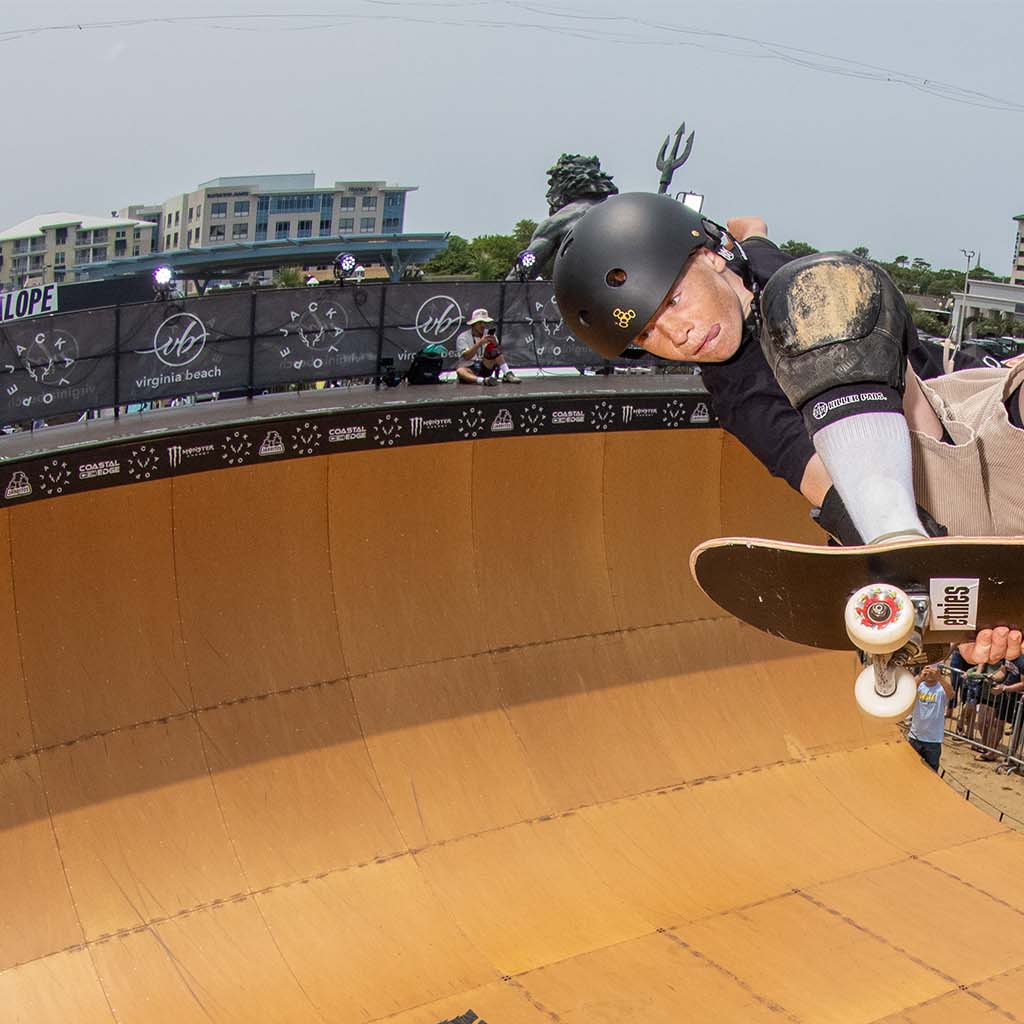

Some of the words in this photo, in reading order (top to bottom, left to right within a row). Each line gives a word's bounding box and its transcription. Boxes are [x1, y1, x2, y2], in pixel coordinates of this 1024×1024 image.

[0, 285, 55, 320] LOPE
[136, 372, 182, 389] virginia
[185, 366, 222, 381] beach
[329, 425, 367, 435] COASTAL
[79, 459, 120, 472] COASTAL
[97, 466, 120, 476] EDGE
[936, 585, 970, 627] etnies
